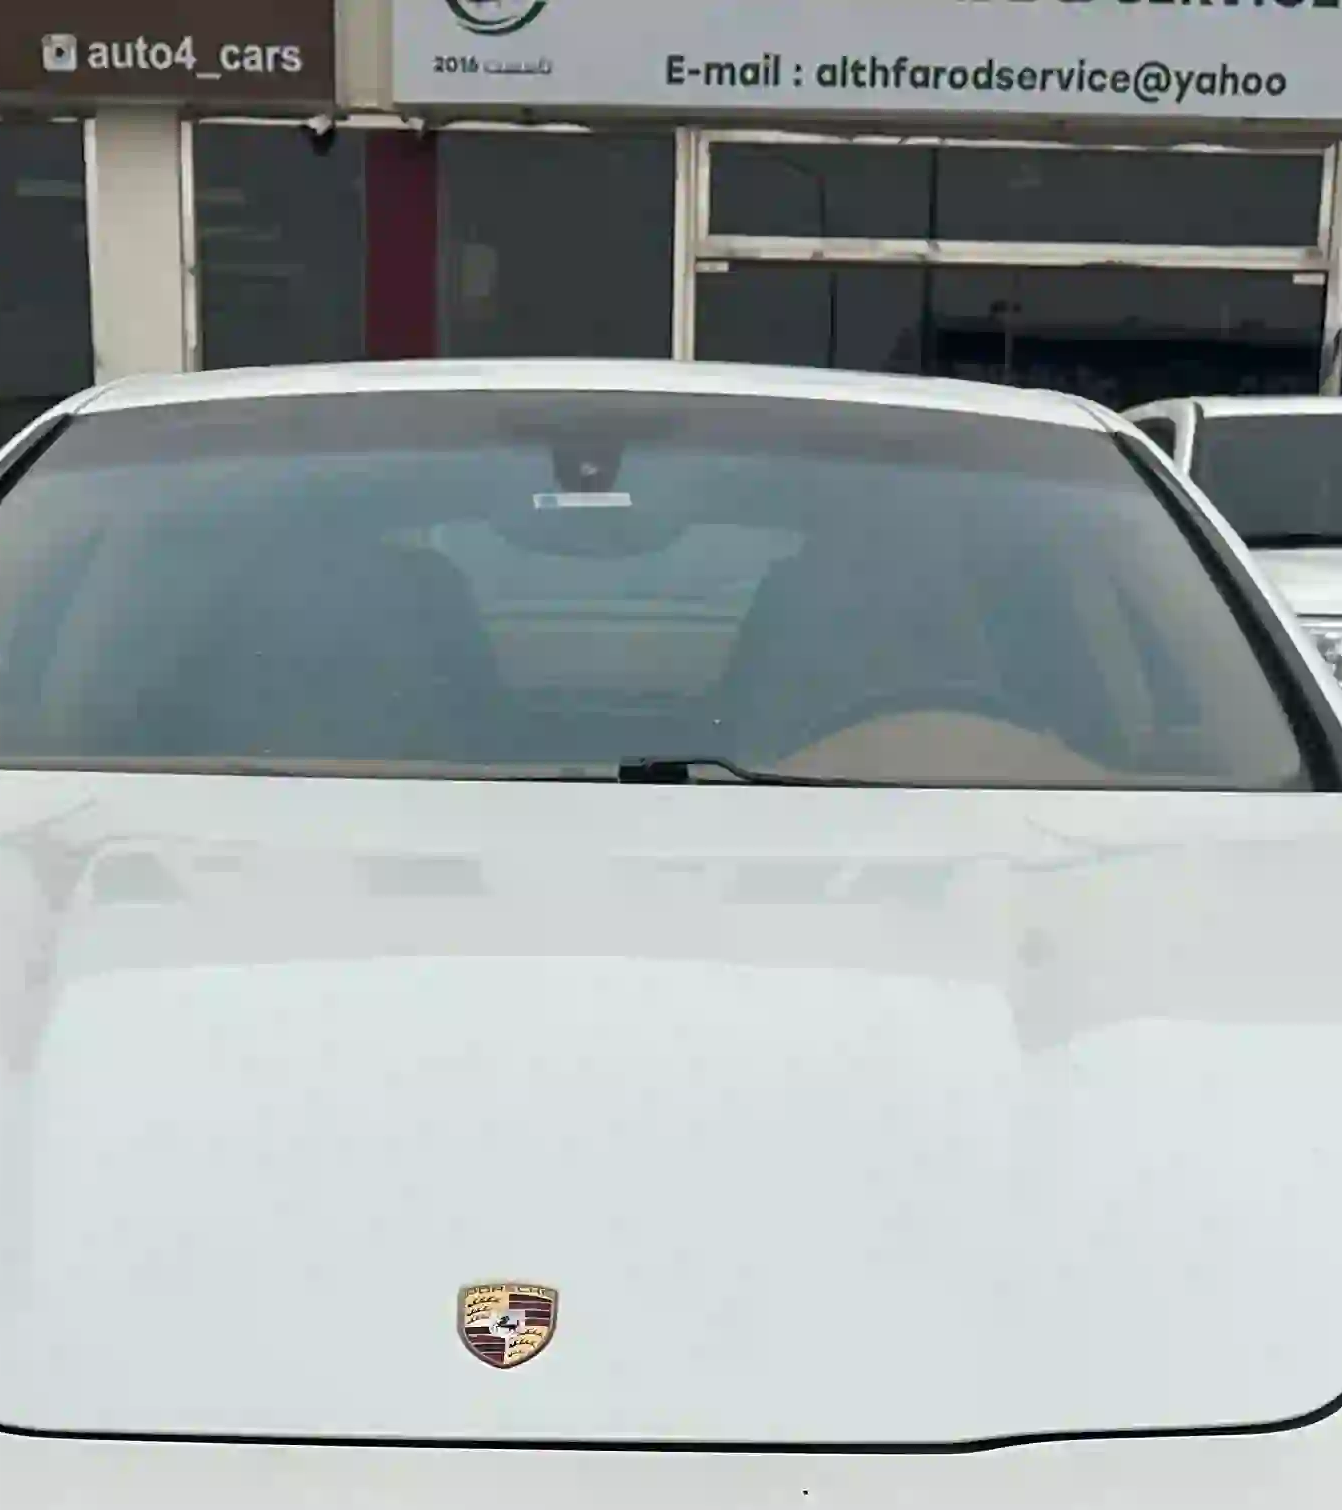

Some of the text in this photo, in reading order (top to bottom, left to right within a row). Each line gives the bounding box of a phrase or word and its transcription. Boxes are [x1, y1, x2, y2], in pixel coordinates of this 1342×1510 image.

[87, 35, 304, 80] auto4_cars
[432, 56, 479, 74] 2016
[665, 53, 780, 87] E-mail
[816, 54, 1288, 103] althfarodservice@yahoo
